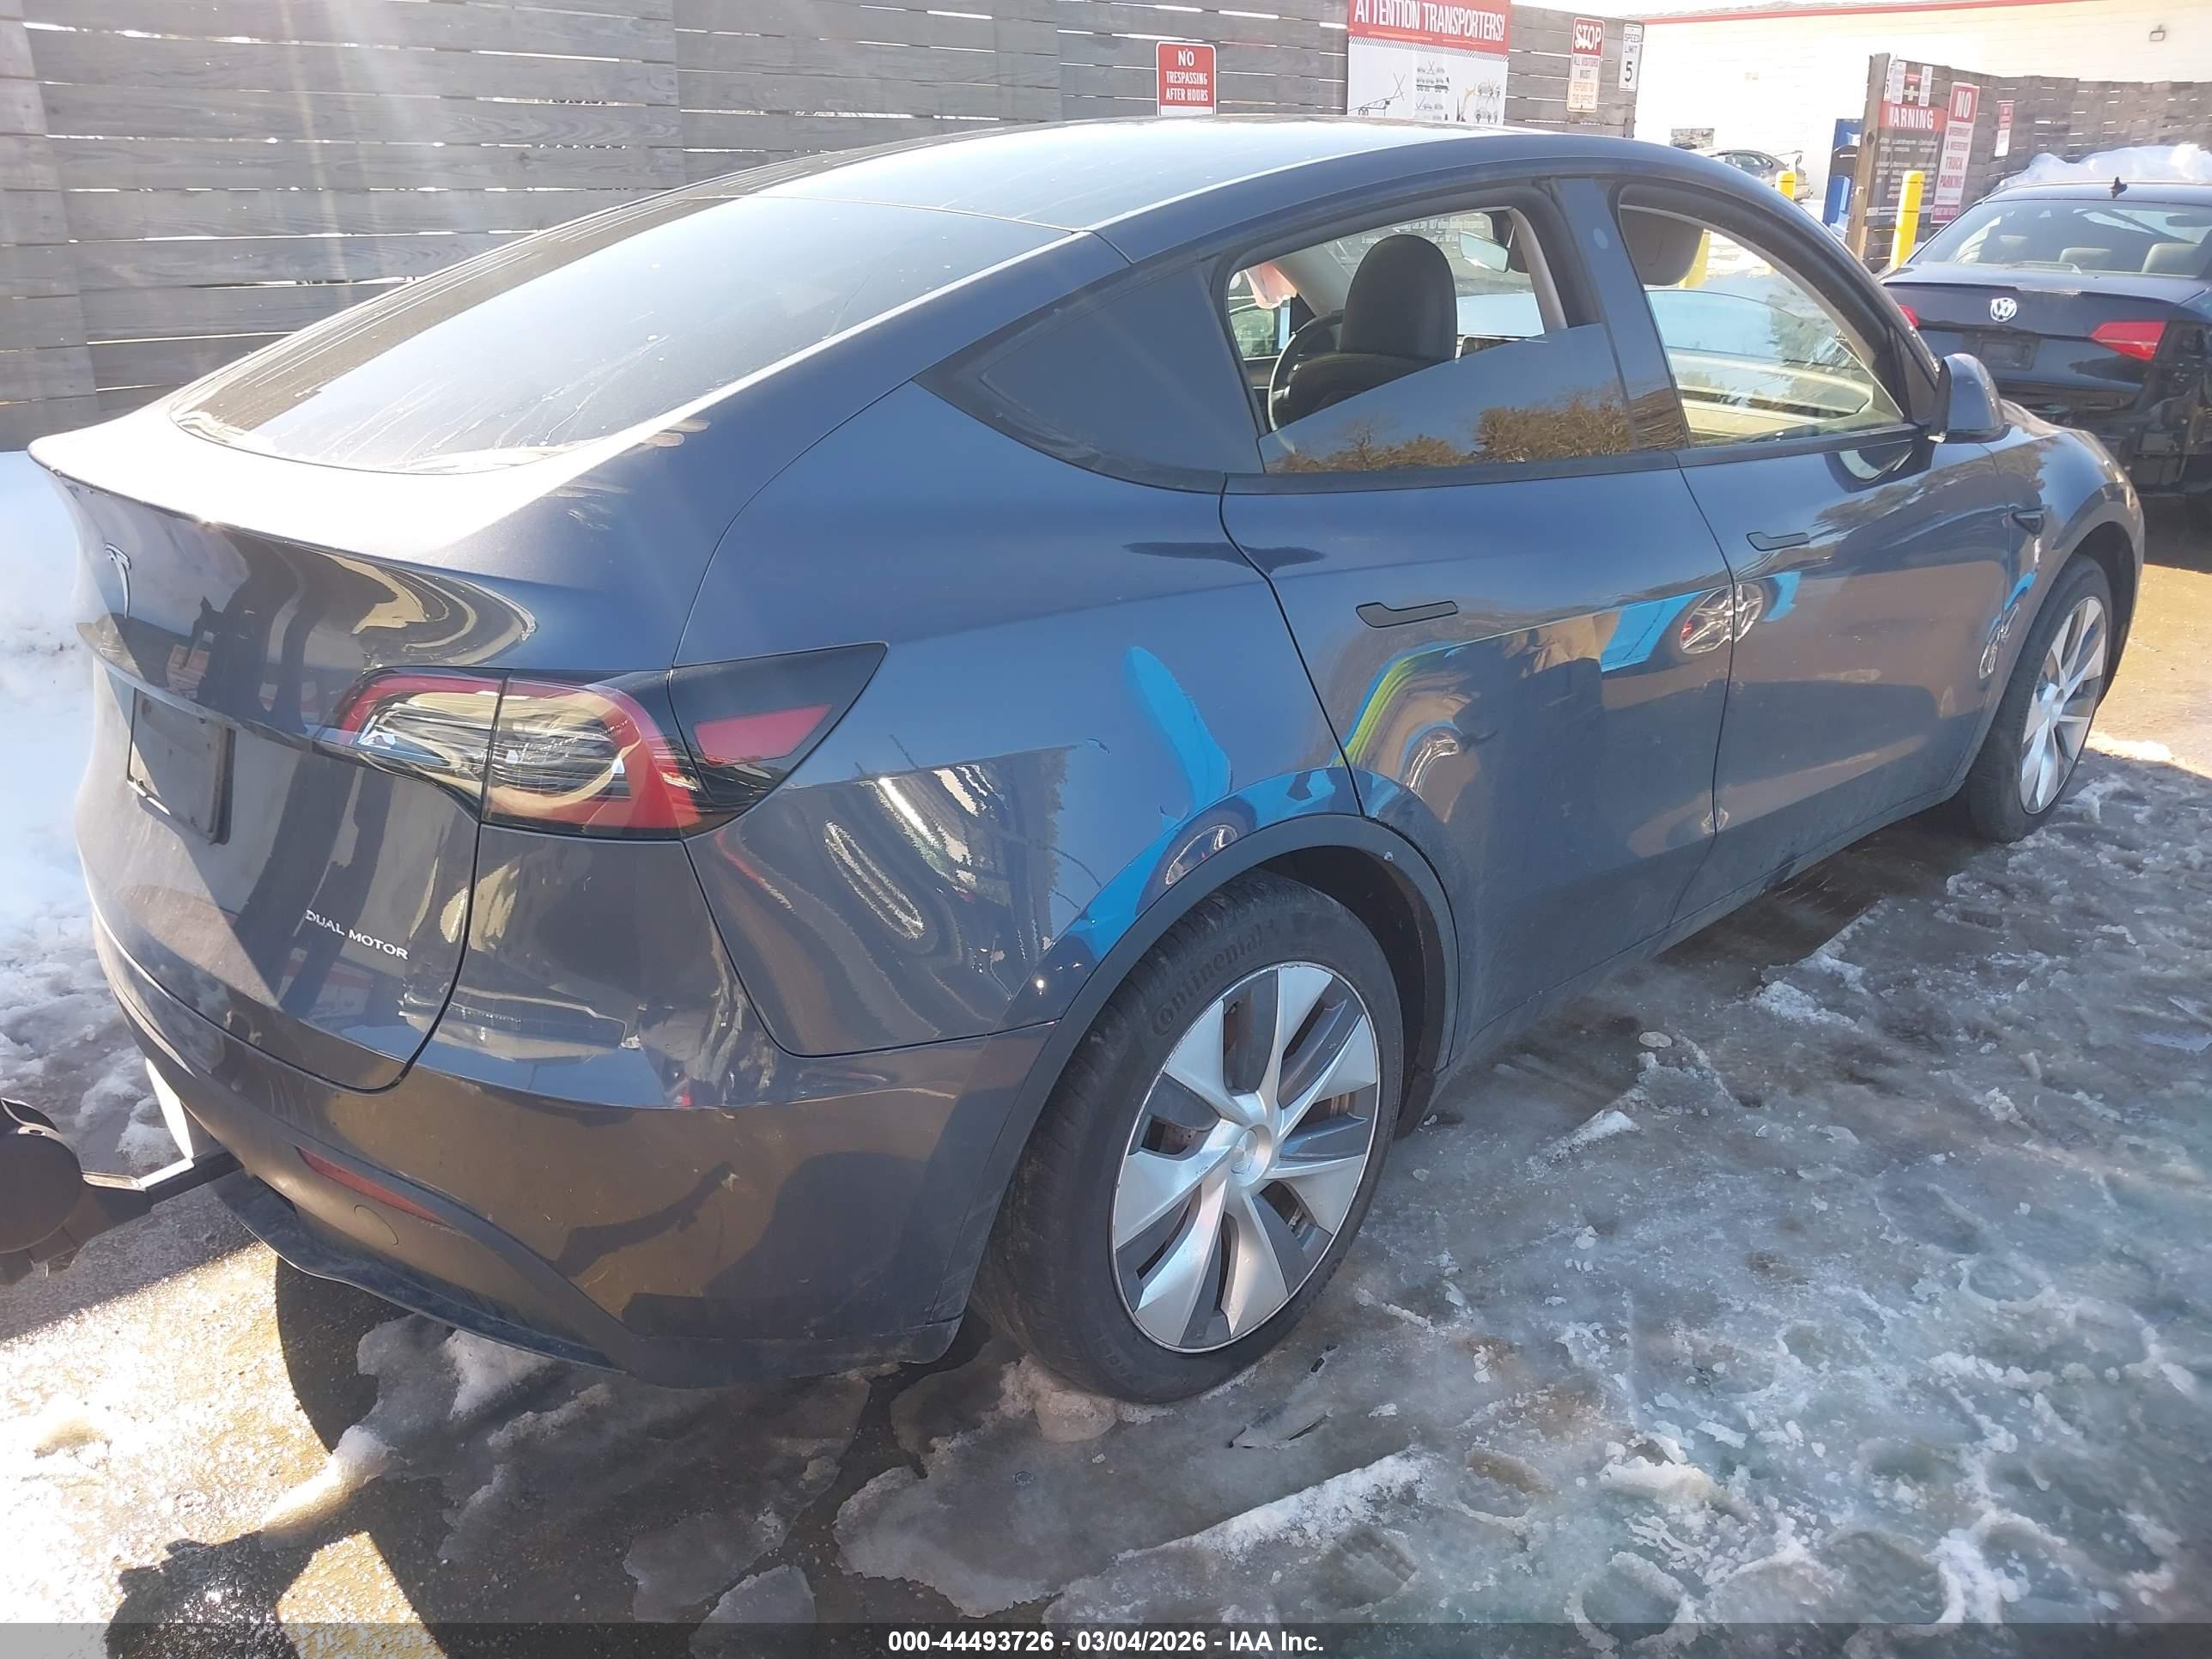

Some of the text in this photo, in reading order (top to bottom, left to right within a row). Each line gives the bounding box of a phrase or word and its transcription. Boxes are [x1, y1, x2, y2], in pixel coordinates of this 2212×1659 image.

[1354, 0, 1505, 41] ATTENTION TRANSPORTERS!
[1575, 24, 1601, 50] STOP
[1178, 49, 1194, 66] NO
[1166, 70, 1208, 85] TRESPASSING
[1625, 60, 1633, 82] 5
[1166, 88, 1208, 101] AFTER HOURS
[1954, 90, 1972, 118] NO
[305, 909, 409, 960] DUAL MOTOR
[1151, 923, 1266, 1037] Continental
